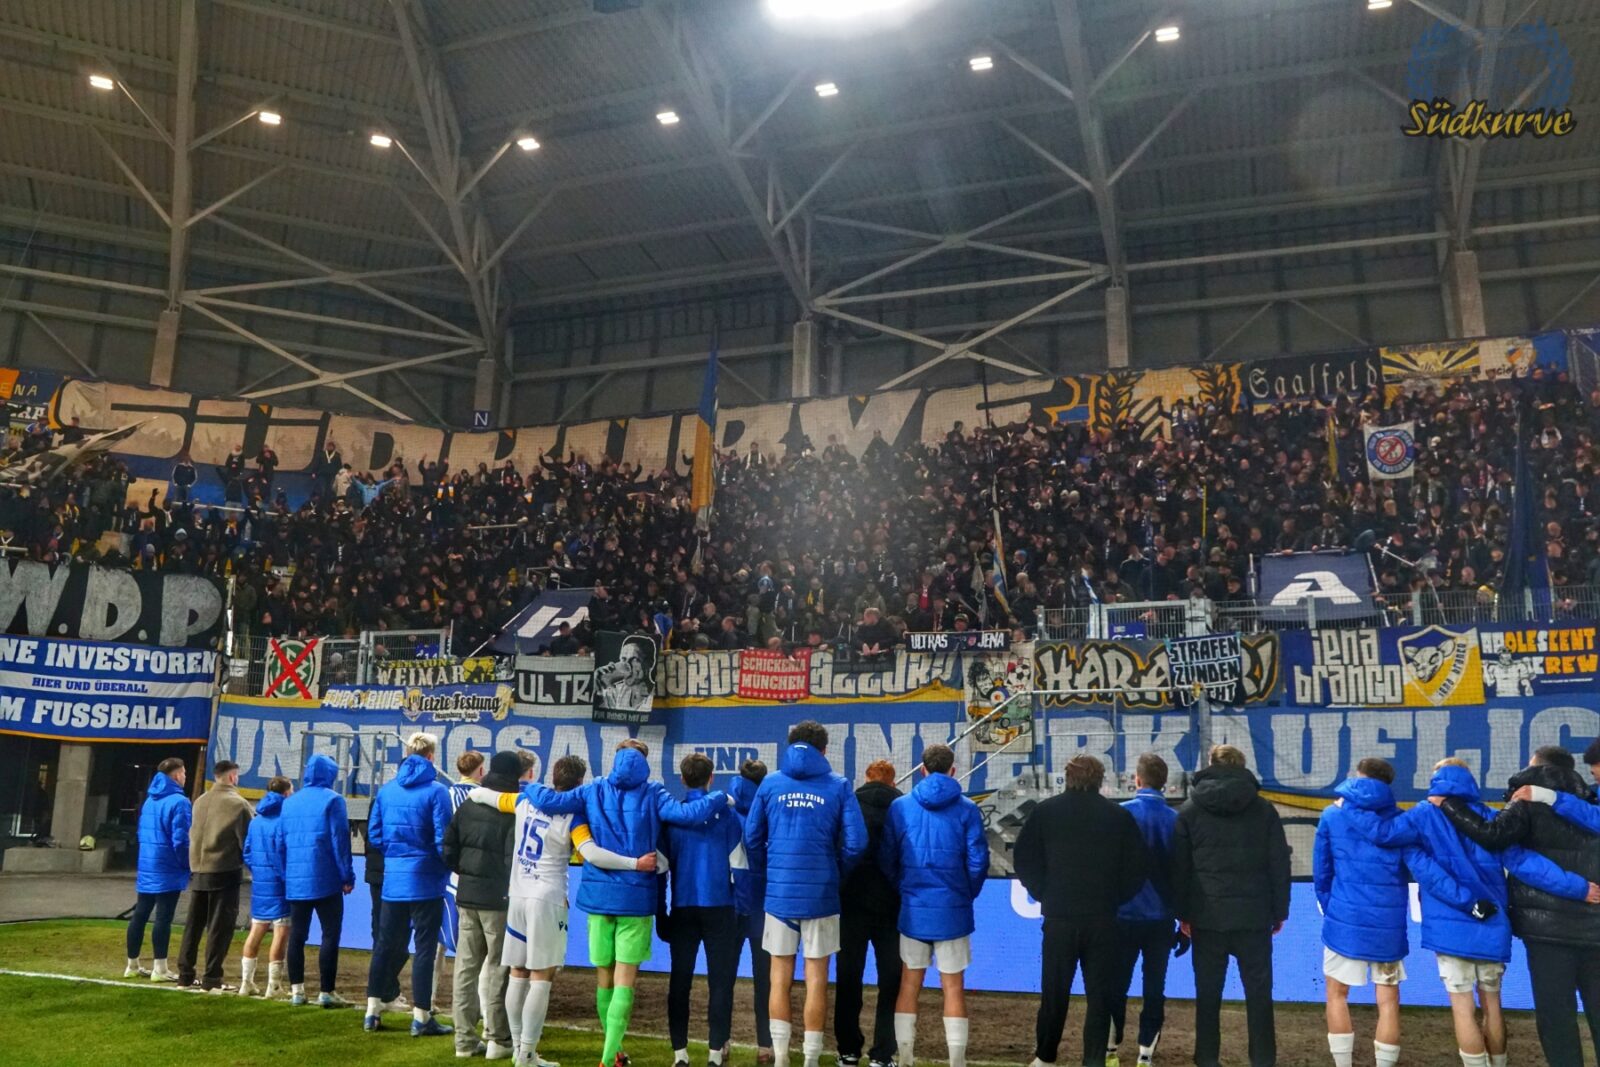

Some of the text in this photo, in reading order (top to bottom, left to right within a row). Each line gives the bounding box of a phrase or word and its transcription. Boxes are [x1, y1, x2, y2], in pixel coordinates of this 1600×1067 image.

[1249, 359, 1378, 398] Saalfeld
[474, 411, 488, 426] N
[911, 631, 1005, 652] ULTRAS JENA
[1169, 636, 1240, 665] STRAFEN
[44, 643, 218, 675] INVESTOREN
[32, 677, 148, 694] HIER UND ÜBERALL
[377, 664, 465, 687] WEIMAR
[518, 673, 595, 704] ULTR
[741, 672, 805, 690] MÜNCHEN
[1294, 665, 1402, 704] branco
[32, 699, 181, 730] FUSSBALL
[786, 800, 814, 809] JENA
[787, 792, 804, 800] CARL
[805, 793, 825, 805] ZEISS
[517, 815, 550, 861] 15
